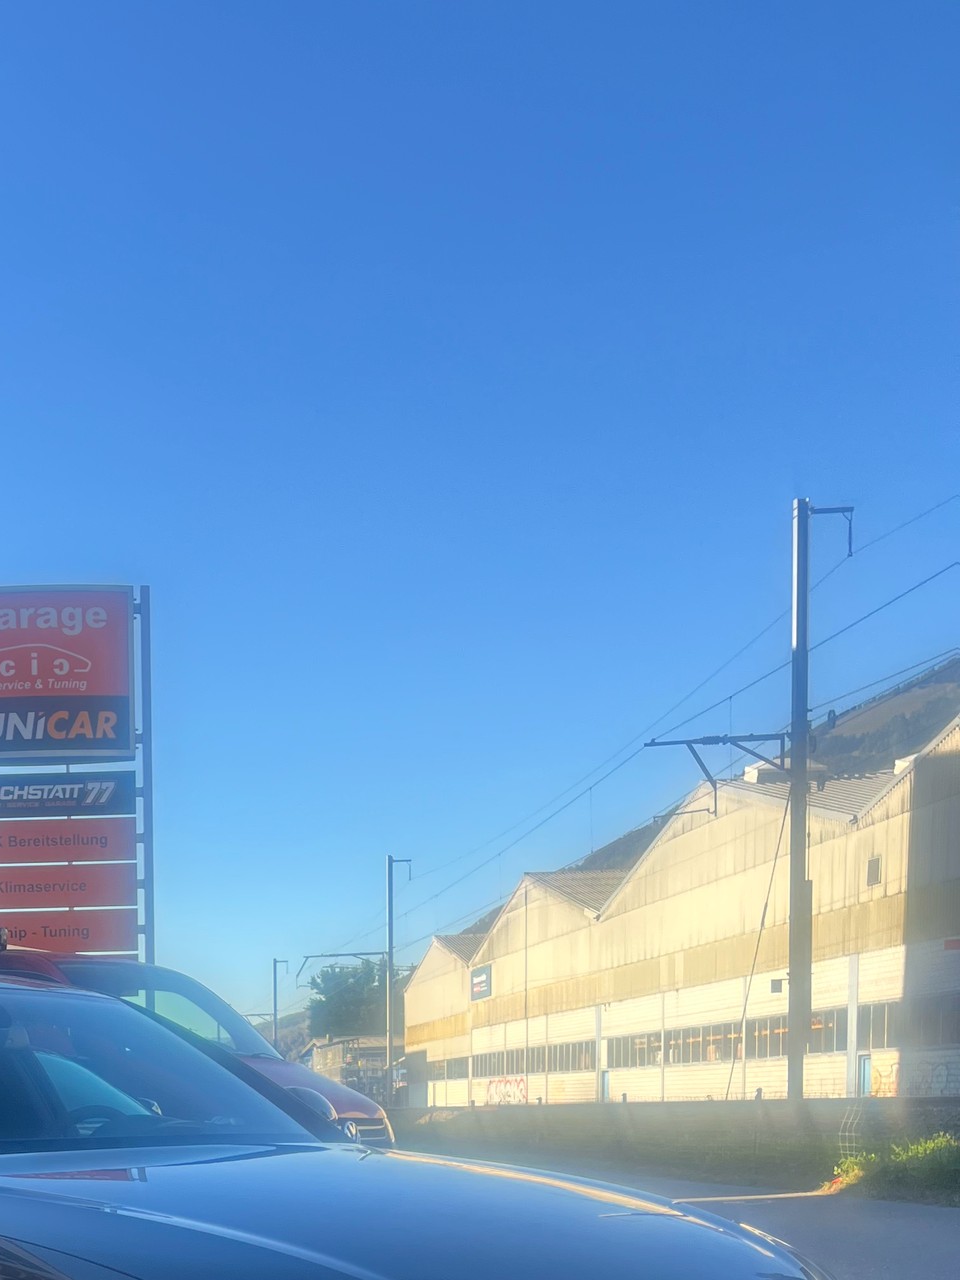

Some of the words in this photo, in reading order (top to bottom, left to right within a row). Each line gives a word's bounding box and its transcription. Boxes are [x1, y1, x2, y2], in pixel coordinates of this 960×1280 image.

[34, 679, 43, 689] &
[47, 678, 88, 691] Tuning
[82, 780, 118, 805] 77
[8, 834, 109, 849] Bereitstellung
[41, 925, 89, 940] Tuning
